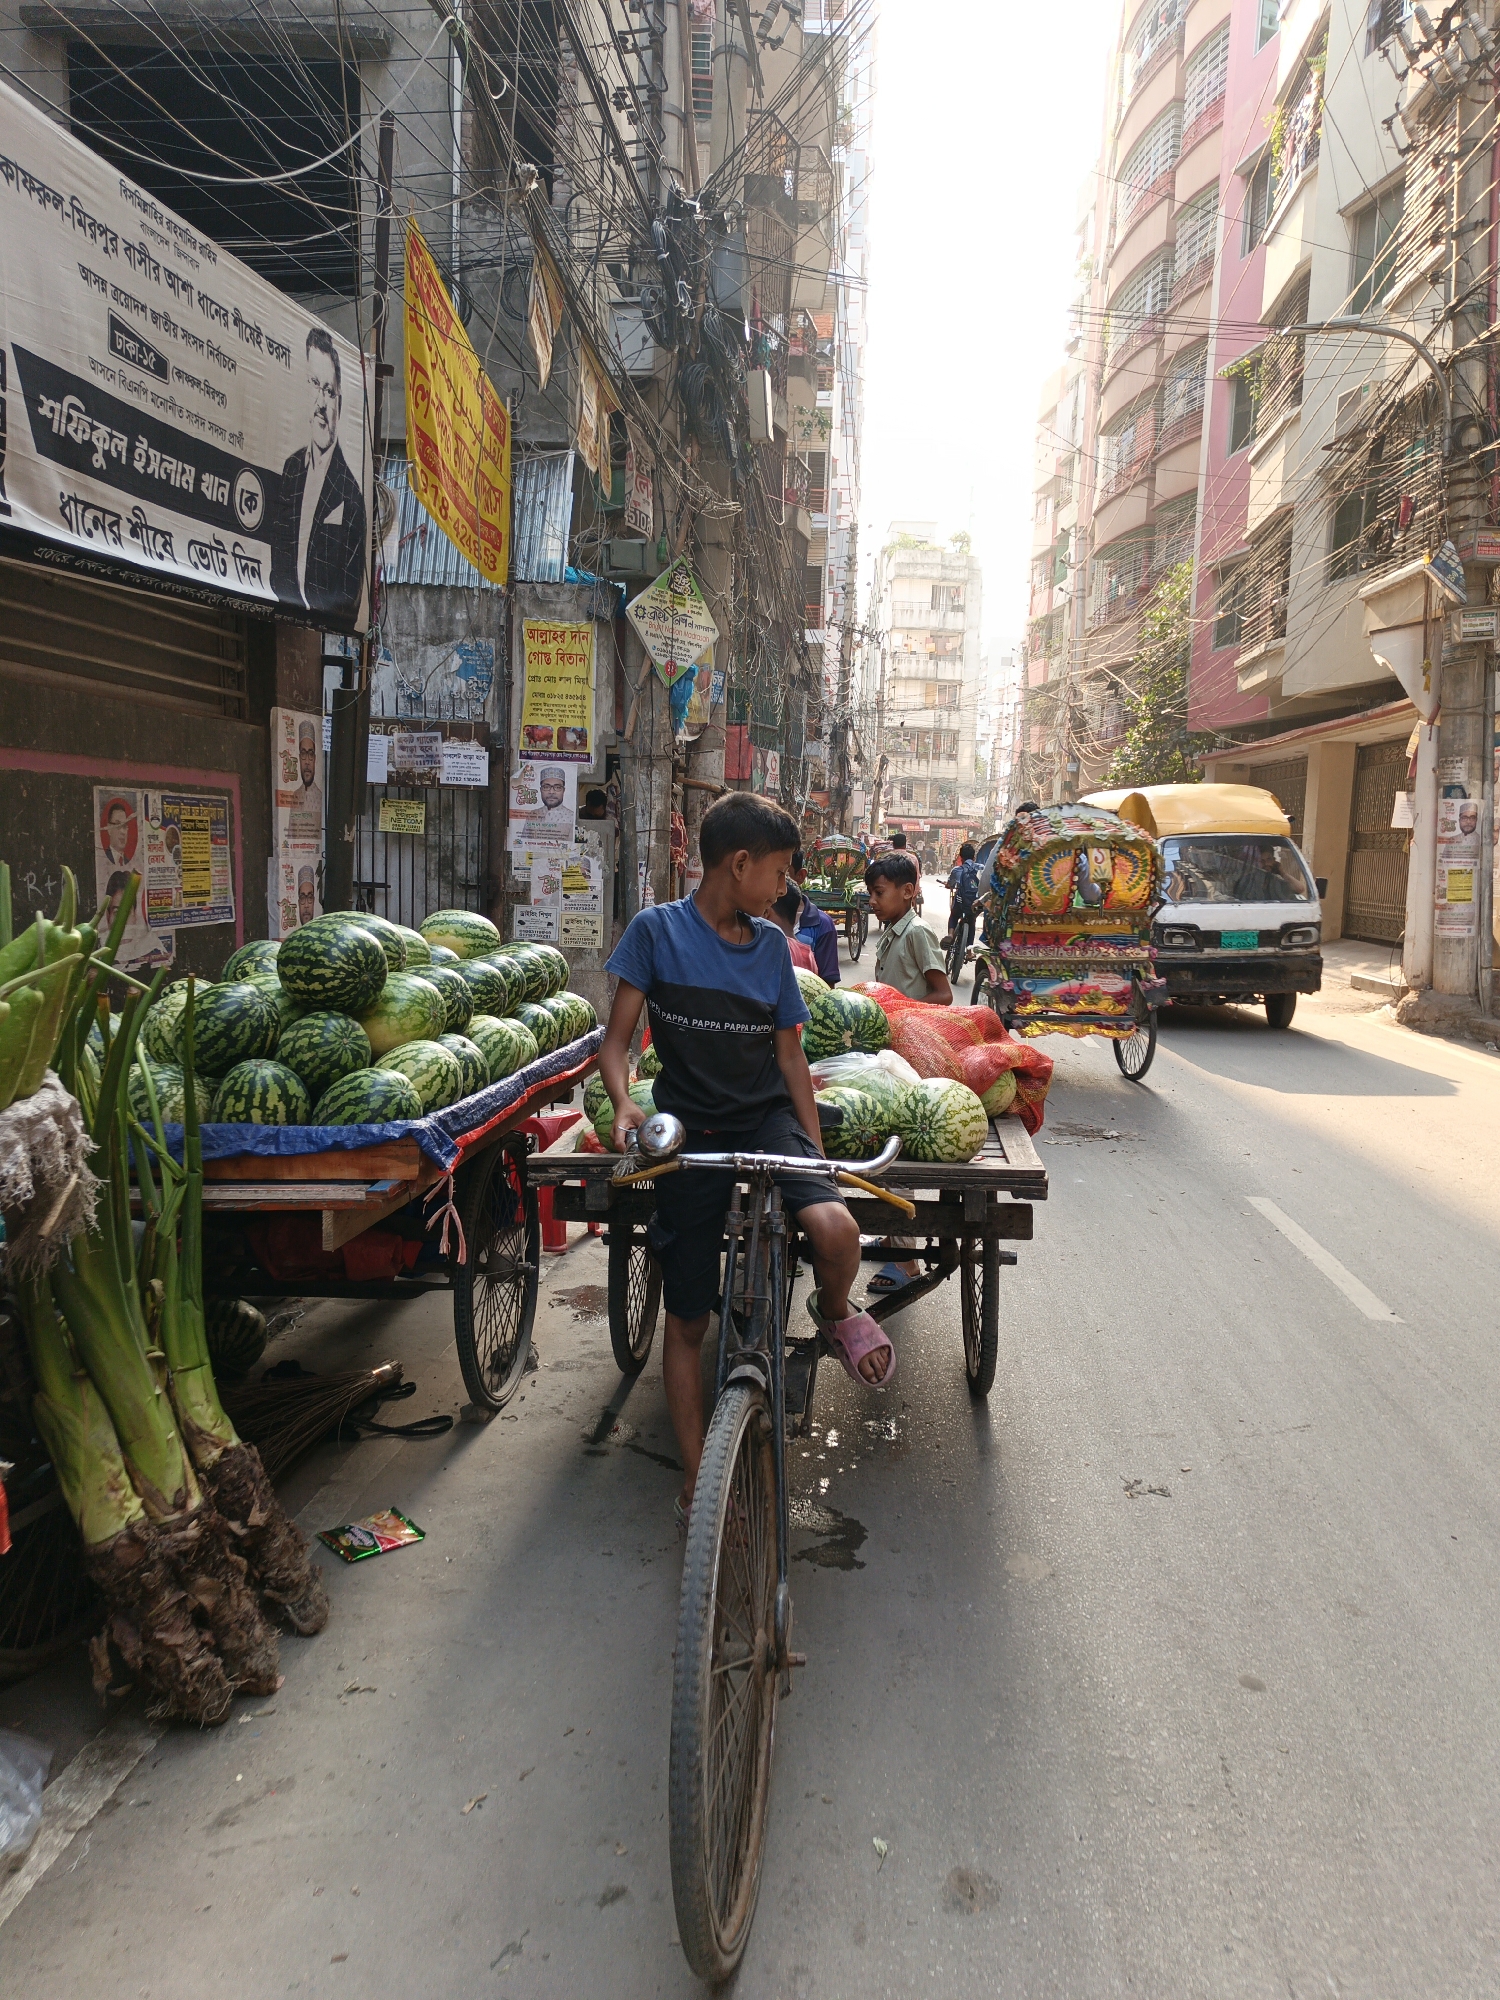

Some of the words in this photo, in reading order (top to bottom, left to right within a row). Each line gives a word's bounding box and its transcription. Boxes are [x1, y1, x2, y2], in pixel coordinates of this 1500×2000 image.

[77, 262, 108, 298] আসন্ন
[180, 327, 205, 356] সংসদ
[206, 339, 237, 375] নির্বাচনে
[122, 237, 161, 285] বাসীর
[162, 266, 195, 309] আশা
[197, 289, 229, 331] ধানের
[231, 307, 264, 354] শীষেই
[265, 335, 291, 369] ভরসা
[114, 329, 157, 371] ঢাকা-১৫
[88, 355, 116, 385] আসনে
[118, 369, 148, 403] বিএনপি
[150, 391, 184, 419] মনোনীত
[185, 409, 206, 430] সংসদ
[38, 394, 128, 471] শফিকুল
[133, 434, 196, 493] ইসলাম
[200, 472, 231, 506] খান
[239, 487, 260, 516] কে
[59, 491, 125, 549] ধানের
[125, 505, 179, 566] শীষে
[187, 533, 229, 578] ভোট
[231, 541, 265, 590] দিন
[527, 628, 566, 645] আল্লাহর
[570, 629, 590, 645] দান
[555, 648, 587, 667] বিতান
[391, 817, 423, 825] NETCOM
[661, 1011, 688, 1025] PAPPA
[692, 1018, 720, 1029] PAPPA
[724, 1022, 748, 1032] PAPPA
